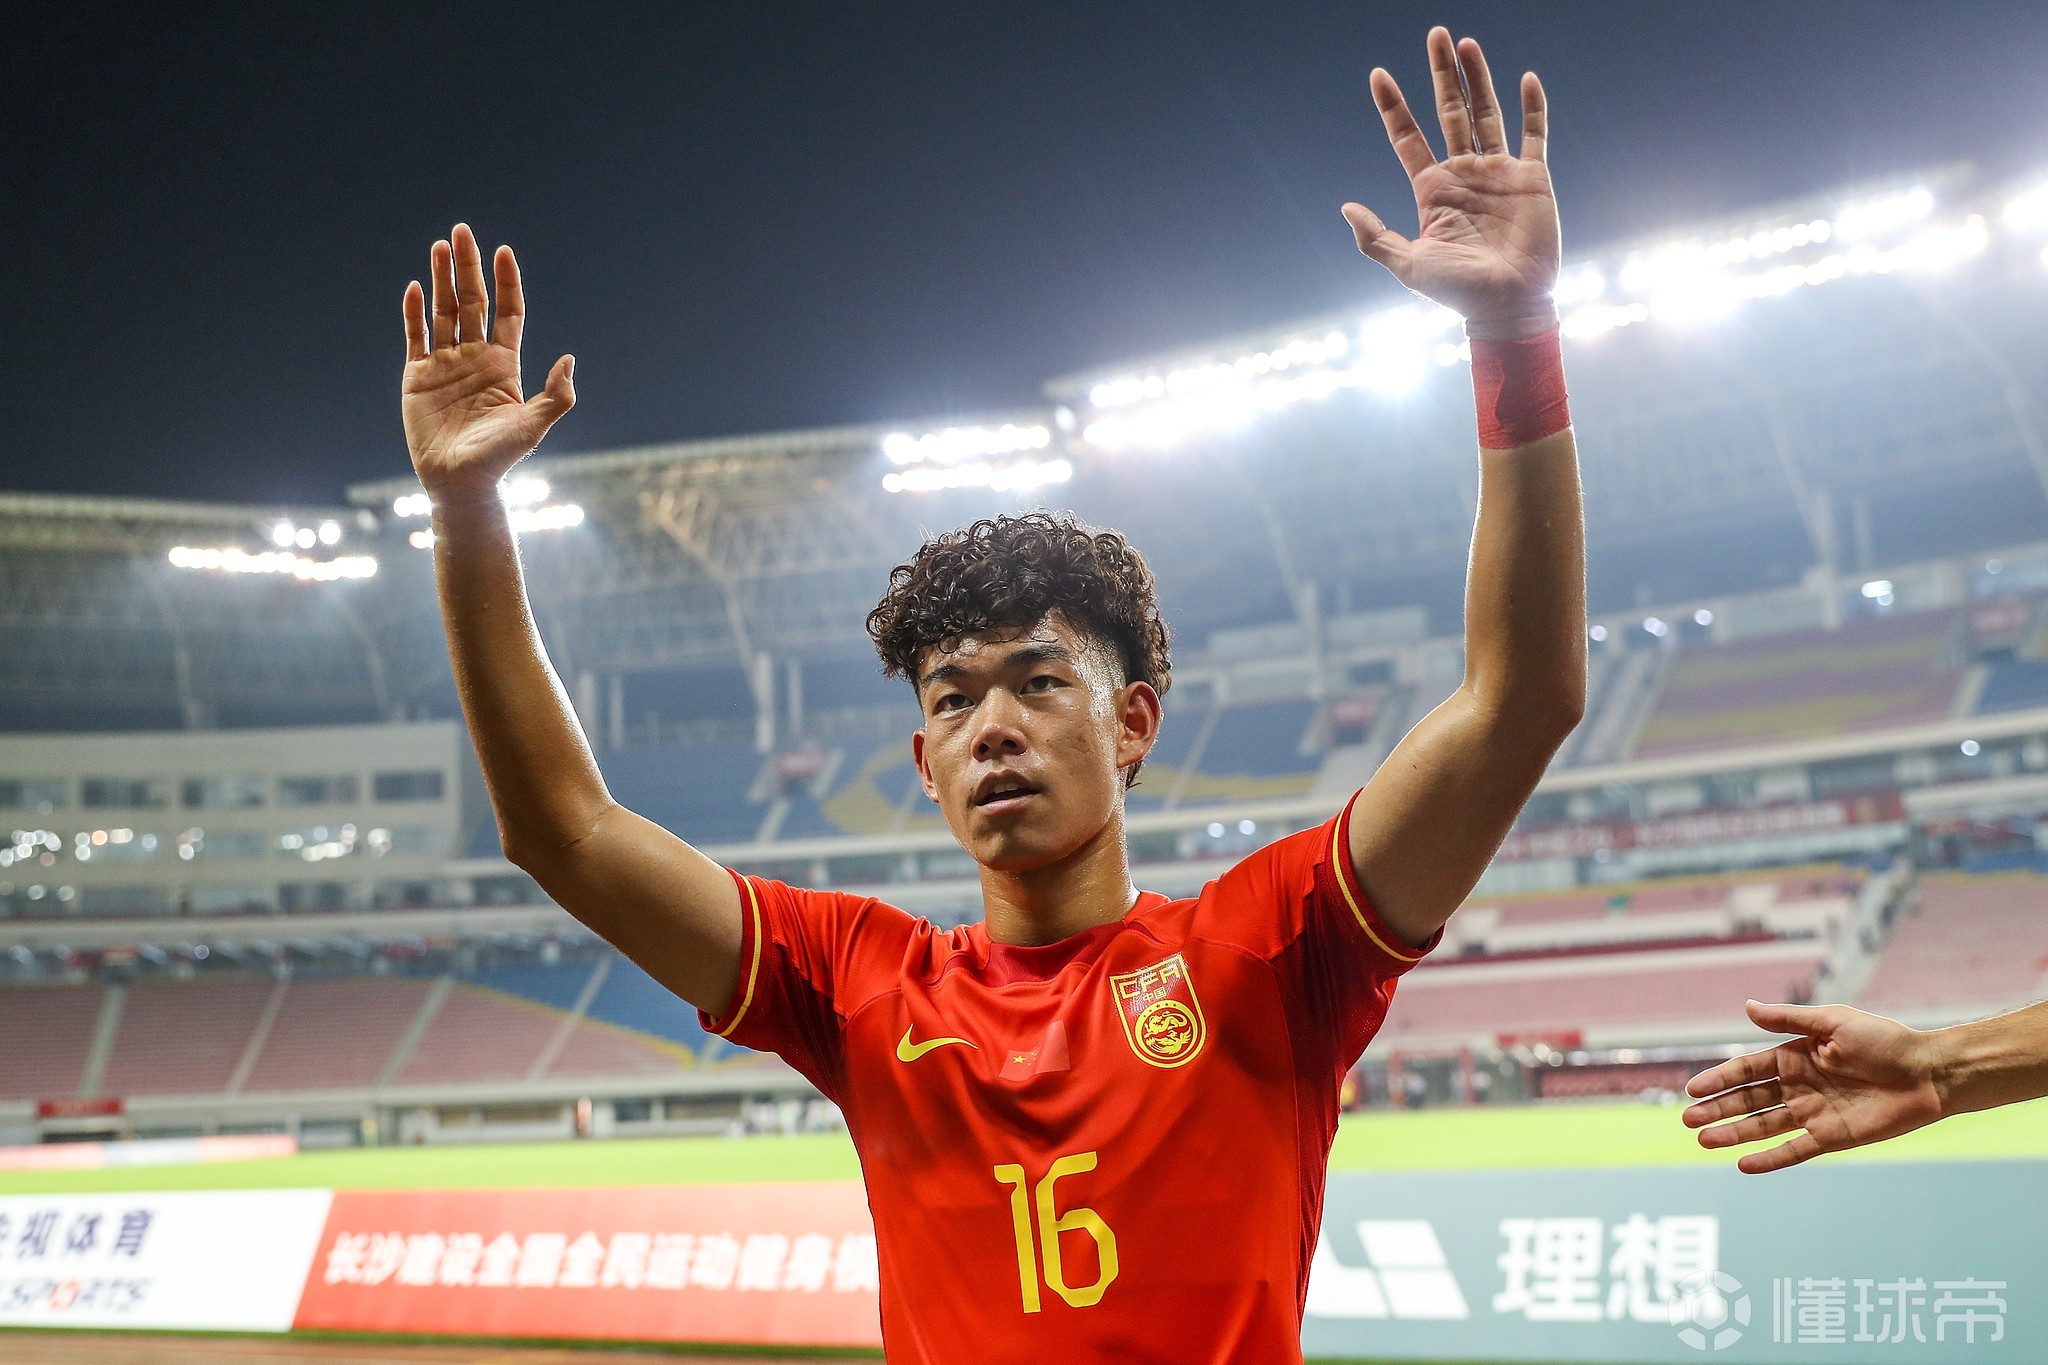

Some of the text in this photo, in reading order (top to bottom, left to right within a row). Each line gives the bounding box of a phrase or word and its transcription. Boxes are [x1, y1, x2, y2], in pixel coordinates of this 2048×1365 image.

[1119, 964, 1181, 999] CFA
[1142, 986, 1167, 1003] 中国
[994, 1151, 1119, 1314] 16
[1492, 1212, 1719, 1322] 理想
